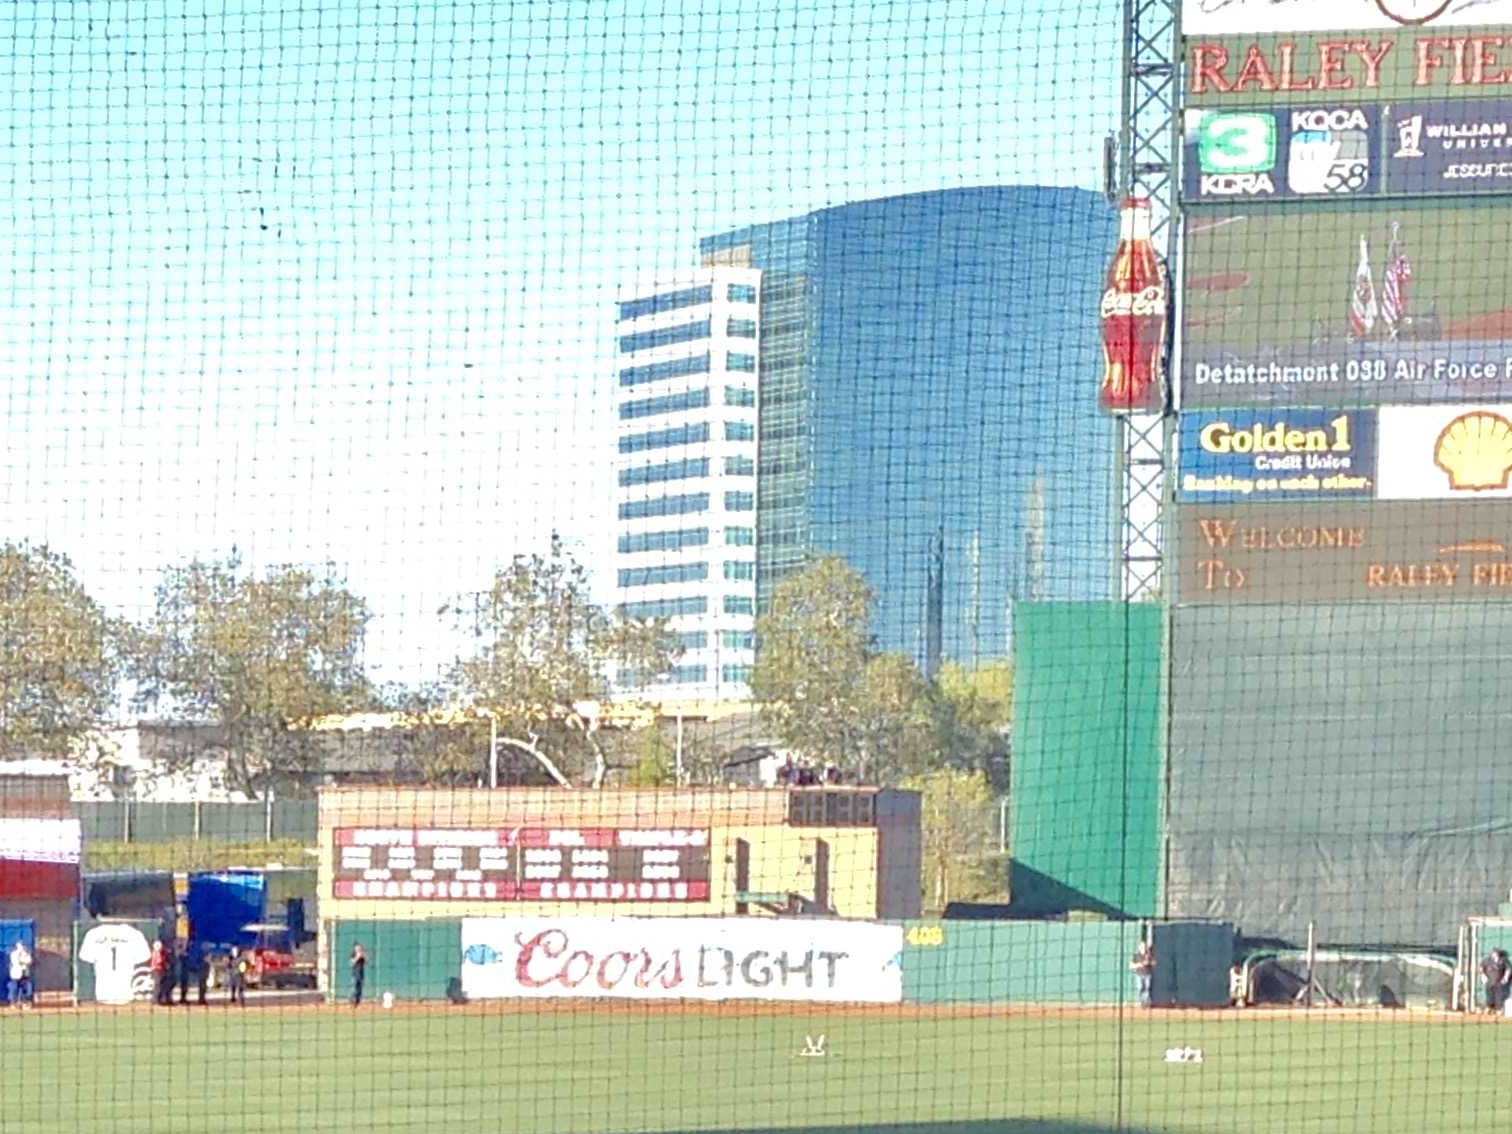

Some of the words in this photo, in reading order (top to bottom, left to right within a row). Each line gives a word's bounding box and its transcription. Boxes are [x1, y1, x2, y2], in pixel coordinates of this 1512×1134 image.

[1191, 38, 1393, 93] RALEY
[1414, 34, 1512, 86] FIE
[1208, 115, 1269, 168] 3
[1324, 163, 1368, 191] 58
[1394, 358, 1426, 380] Air
[1434, 358, 1497, 379] Force
[514, 929, 686, 989] Coors
[697, 943, 849, 988] LIGHT
